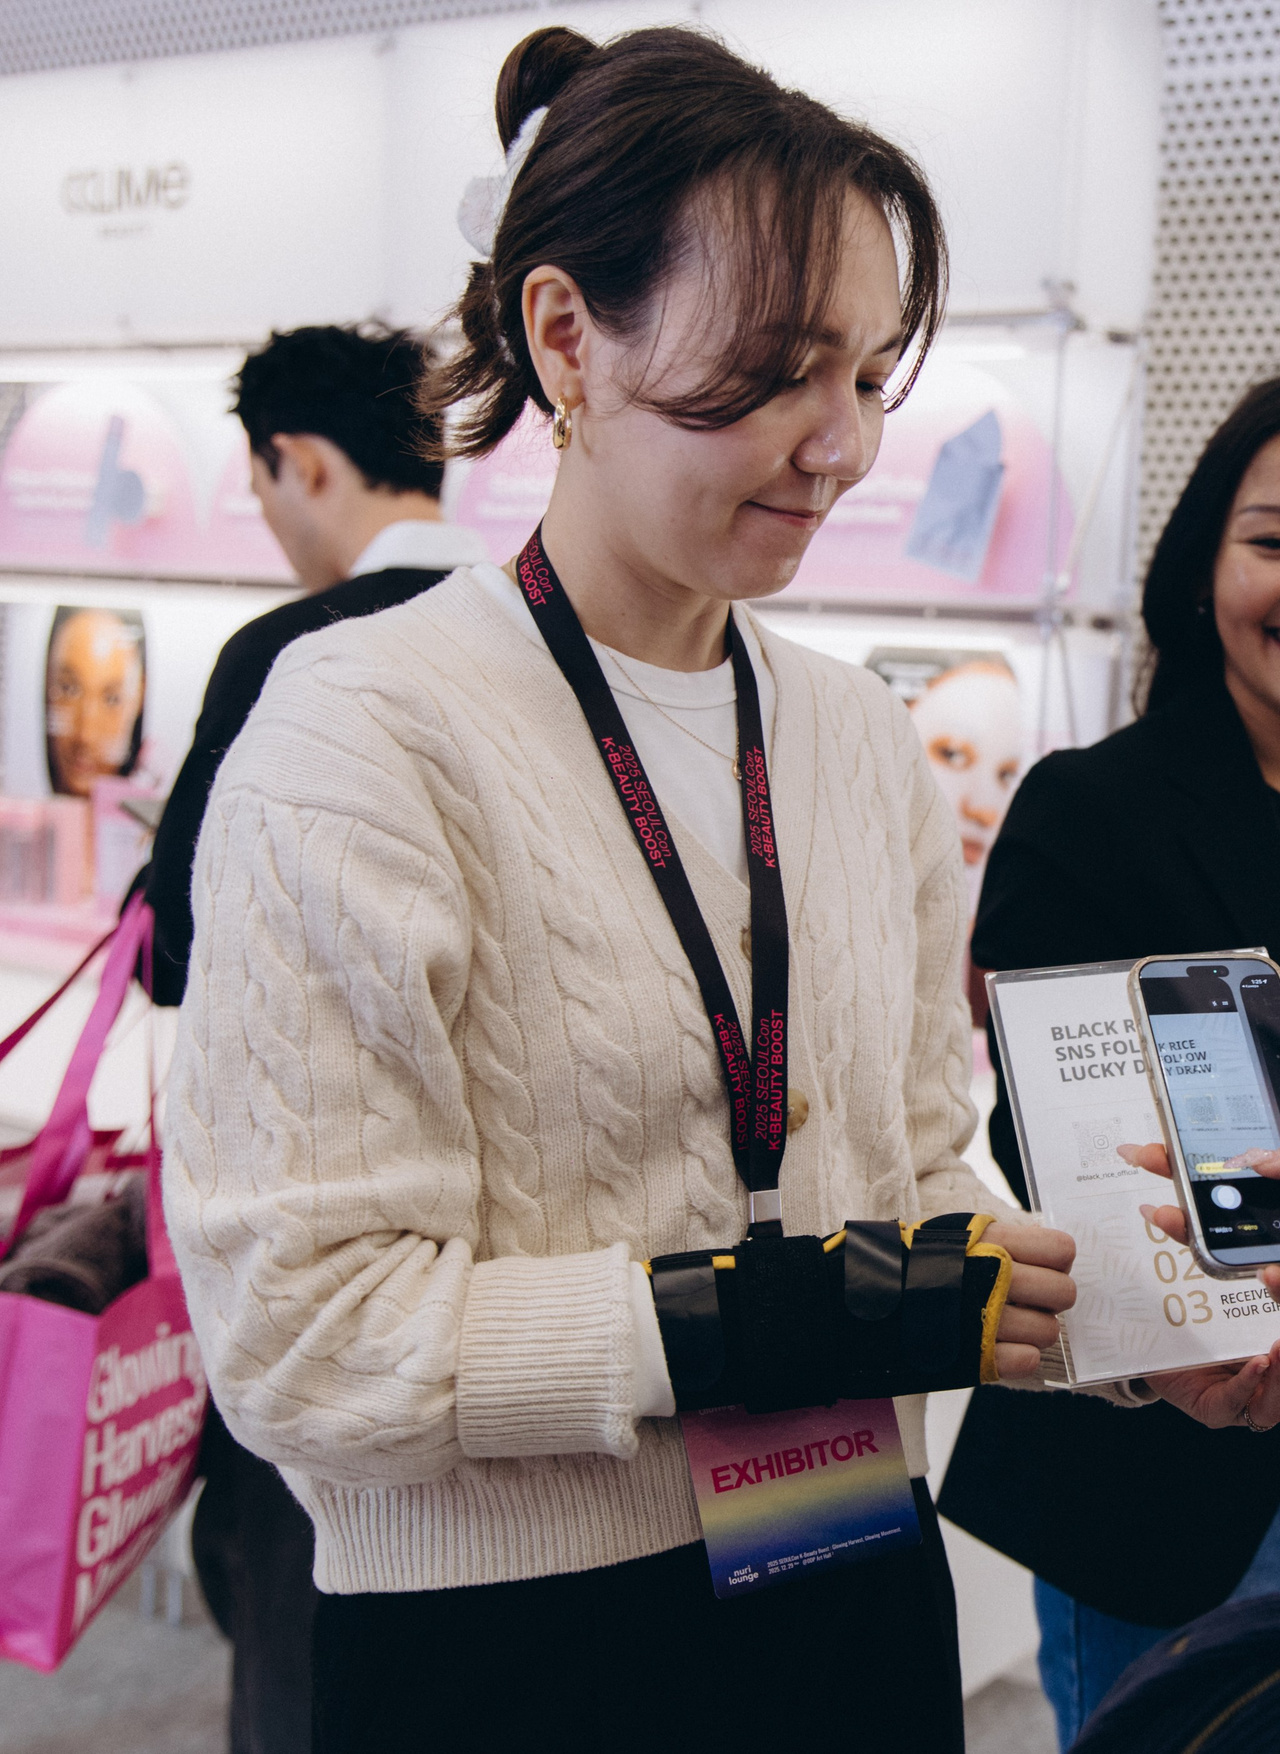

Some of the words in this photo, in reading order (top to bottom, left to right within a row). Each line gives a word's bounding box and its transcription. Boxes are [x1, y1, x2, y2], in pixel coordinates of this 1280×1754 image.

[520, 562, 547, 606] BOOST
[745, 750, 760, 823] SEOULCon
[753, 745, 768, 796] BOOST
[601, 737, 643, 812] K-BEAUTY
[634, 816, 666, 869] BOOST
[618, 745, 642, 777] 2025
[634, 781, 672, 857] SEOULCon
[750, 824, 763, 857] 2025
[759, 797, 776, 868] K-BEAUTY
[727, 1021, 744, 1056] 2025
[771, 1009, 783, 1065] BOOST
[1050, 1020, 1118, 1041] BLACK
[1168, 1039, 1196, 1051] RICE
[714, 1013, 744, 1093] K-BEAUTY
[756, 1018, 770, 1101] SEOULCon
[1055, 1043, 1096, 1062] SNS
[1059, 1060, 1126, 1082] LUCKY
[1175, 1063, 1212, 1075] DRAW
[755, 1103, 769, 1140] 2025
[768, 1068, 783, 1151] K-BEAUTY
[1153, 1247, 1205, 1284] 02
[1162, 1289, 1213, 1327] 03
[1220, 1287, 1271, 1305] RECEIVE
[1223, 1304, 1260, 1319] YOUR
[710, 1429, 880, 1494] EXHIBITOR
[728, 1571, 759, 1586] lounge
[733, 1565, 752, 1577] nuri
